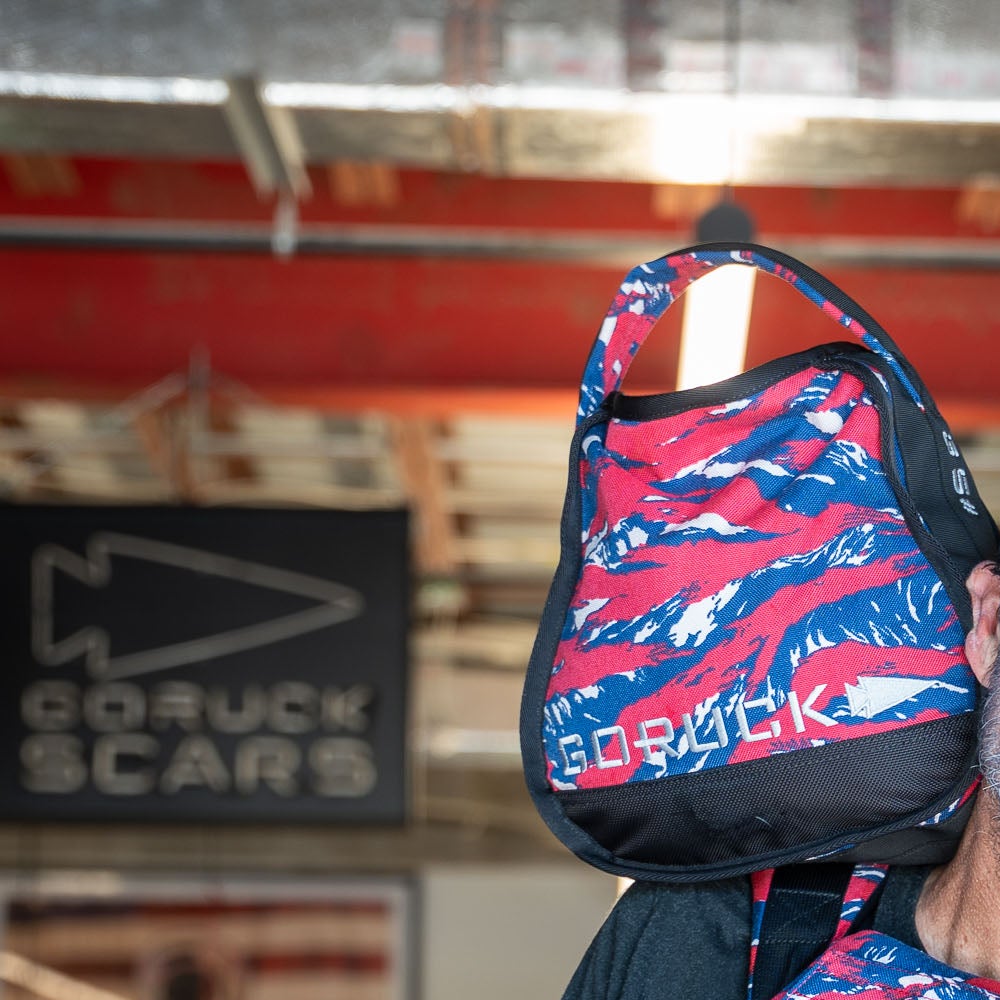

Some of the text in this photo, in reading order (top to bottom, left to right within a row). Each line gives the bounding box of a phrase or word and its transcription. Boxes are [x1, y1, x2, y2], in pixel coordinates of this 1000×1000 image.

[20, 680, 374, 732] GORUCK
[558, 683, 839, 777] GORUCK
[20, 733, 378, 797] SCARS
